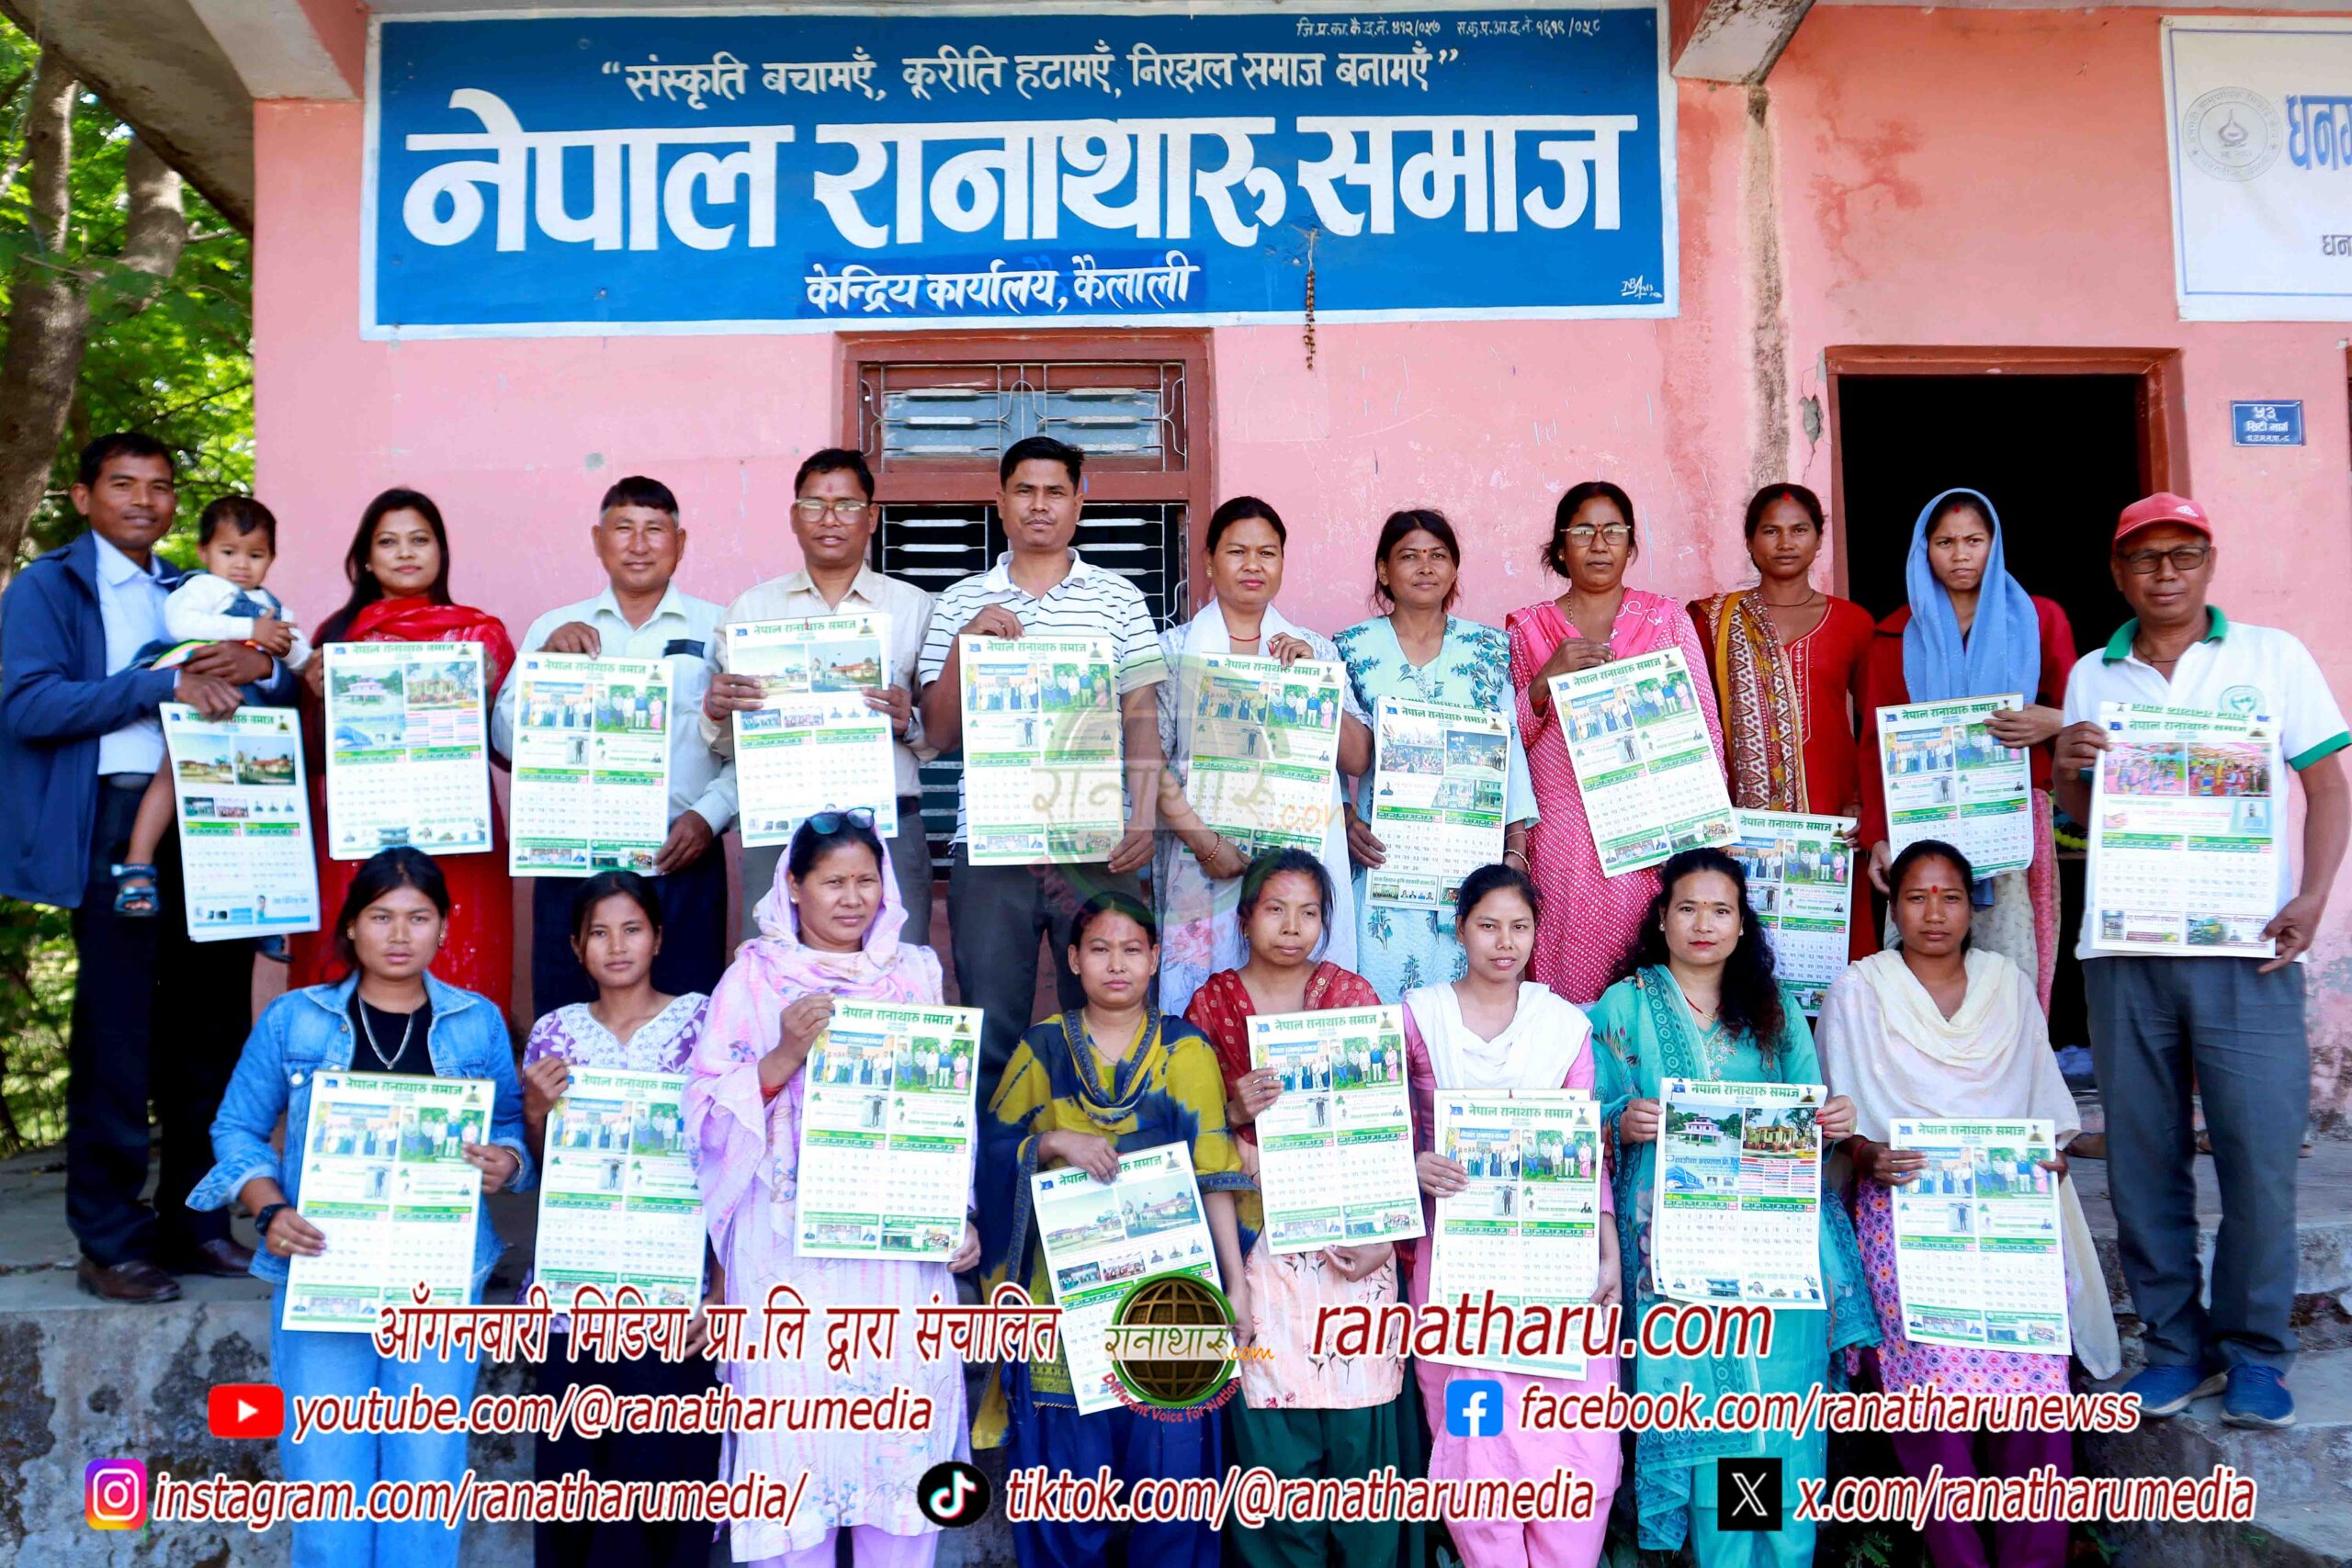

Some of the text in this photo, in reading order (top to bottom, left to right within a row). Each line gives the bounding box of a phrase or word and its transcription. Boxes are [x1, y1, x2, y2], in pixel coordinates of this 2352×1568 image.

[901, 45, 1009, 100] कूरीति
[1126, 42, 1237, 93] निरझल
[1242, 52, 1327, 90] समाज
[402, 87, 1639, 252] नेपाल रानाथारु समाज
[804, 250, 1201, 314] केन्द्रिय कार्यालय, कैलाली
[752, 624, 781, 635] नेपाल
[828, 619, 856, 630] समाज
[987, 641, 1087, 652] नेपाल रानाथारु समाज
[1224, 658, 1250, 671] नेपाल
[1294, 664, 1320, 677] समाज
[1573, 657, 1661, 687] नेपाल रानाथारु समाज
[1401, 705, 1425, 717] नेपाल
[1428, 708, 1462, 722] रानाथारु
[1464, 714, 1487, 724] समाज
[1902, 701, 1999, 720] नेपाल रानाथारु समाज
[1739, 815, 1832, 832] नेपाल रानाथारु समाज
[842, 1006, 954, 1026] नेपाल रानाथारु समाज
[1274, 1013, 1377, 1031] नेपाल रानाथारु समाज
[582, 1073, 684, 1092] नेपाल रानाथारु समा
[1468, 1103, 1573, 1119] नेपाल रानाथारु समाज
[1917, 1122, 2026, 1136] नेपाल रानाथारु समाज
[1059, 1172, 1088, 1186] नेपाल
[1132, 1155, 1162, 1168] समाज
